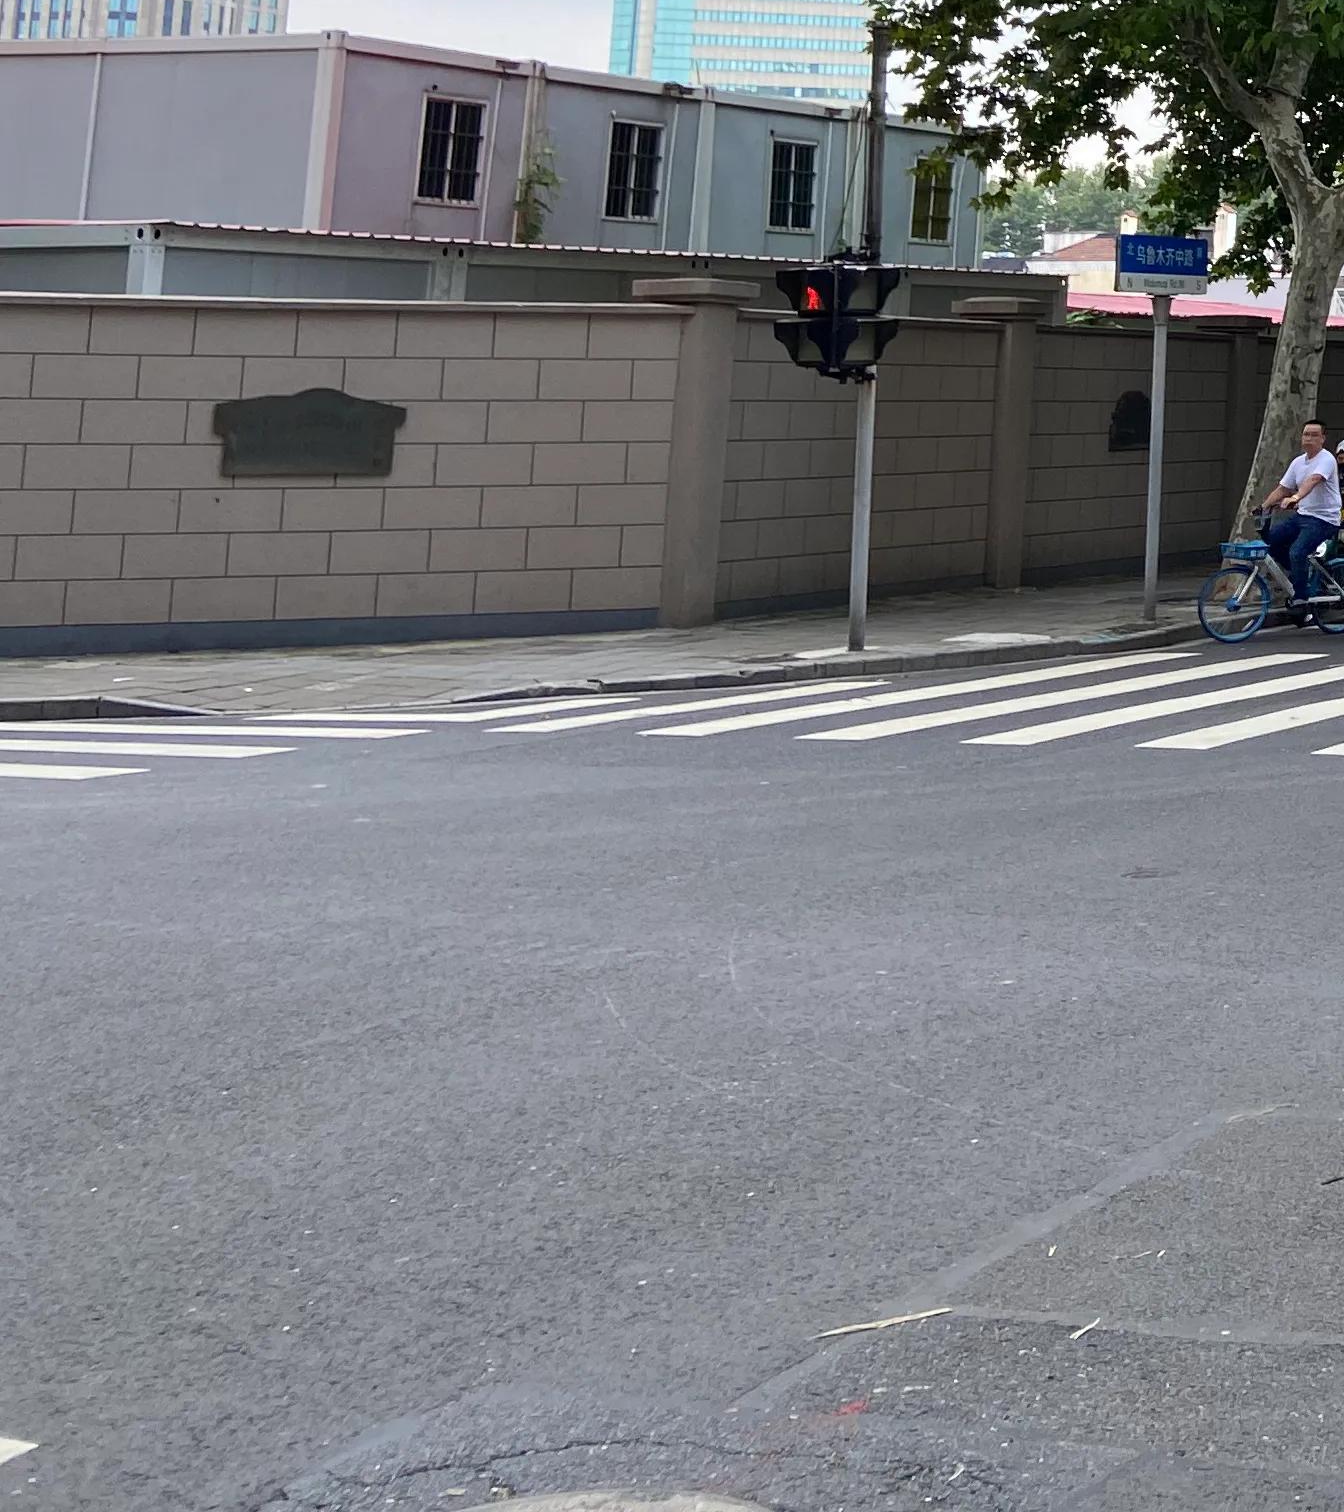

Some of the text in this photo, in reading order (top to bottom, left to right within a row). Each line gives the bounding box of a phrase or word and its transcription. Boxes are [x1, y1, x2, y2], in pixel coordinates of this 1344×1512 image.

[1136, 245, 1194, 267] 乌鲁木齐中路
